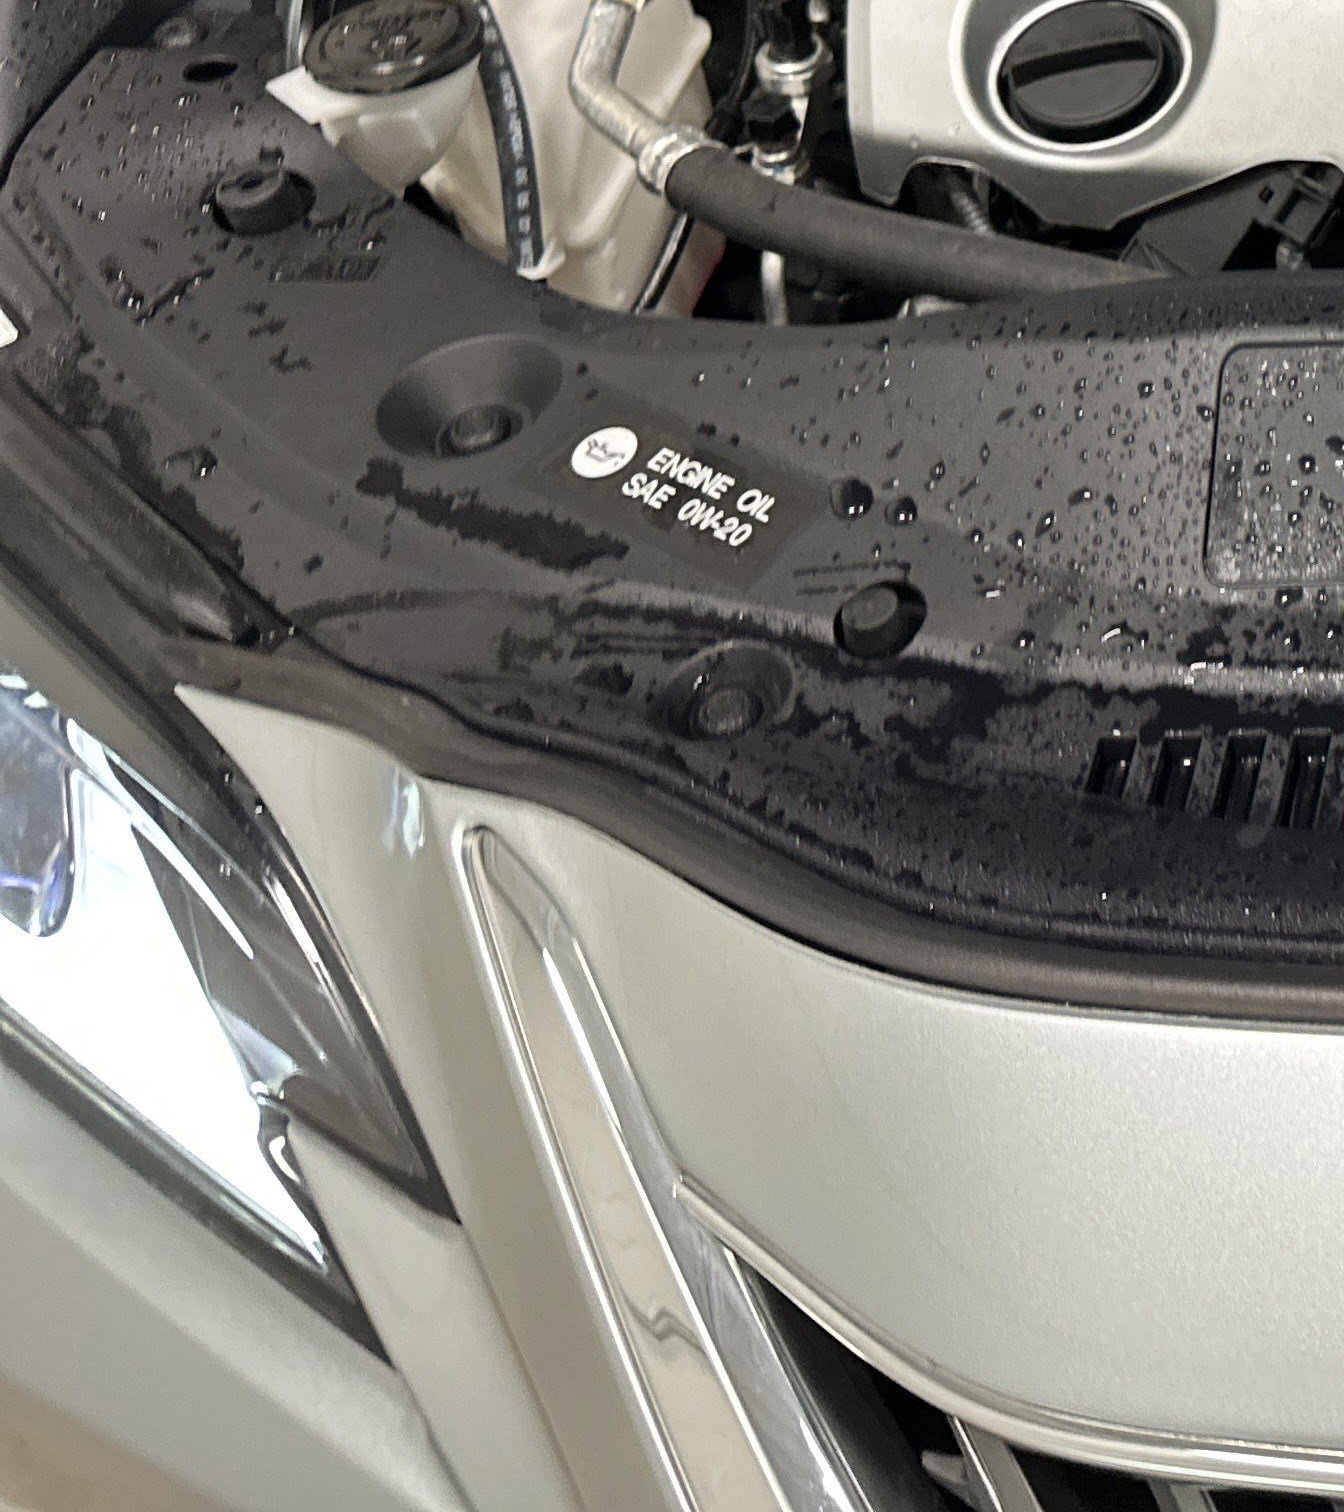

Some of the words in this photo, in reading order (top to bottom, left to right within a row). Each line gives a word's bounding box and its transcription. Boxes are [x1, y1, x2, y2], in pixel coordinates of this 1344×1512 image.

[622, 473, 677, 510] SAE
[677, 499, 753, 547] 0W-20
[647, 447, 735, 499] ENGINE
[737, 489, 775, 523] OIL
